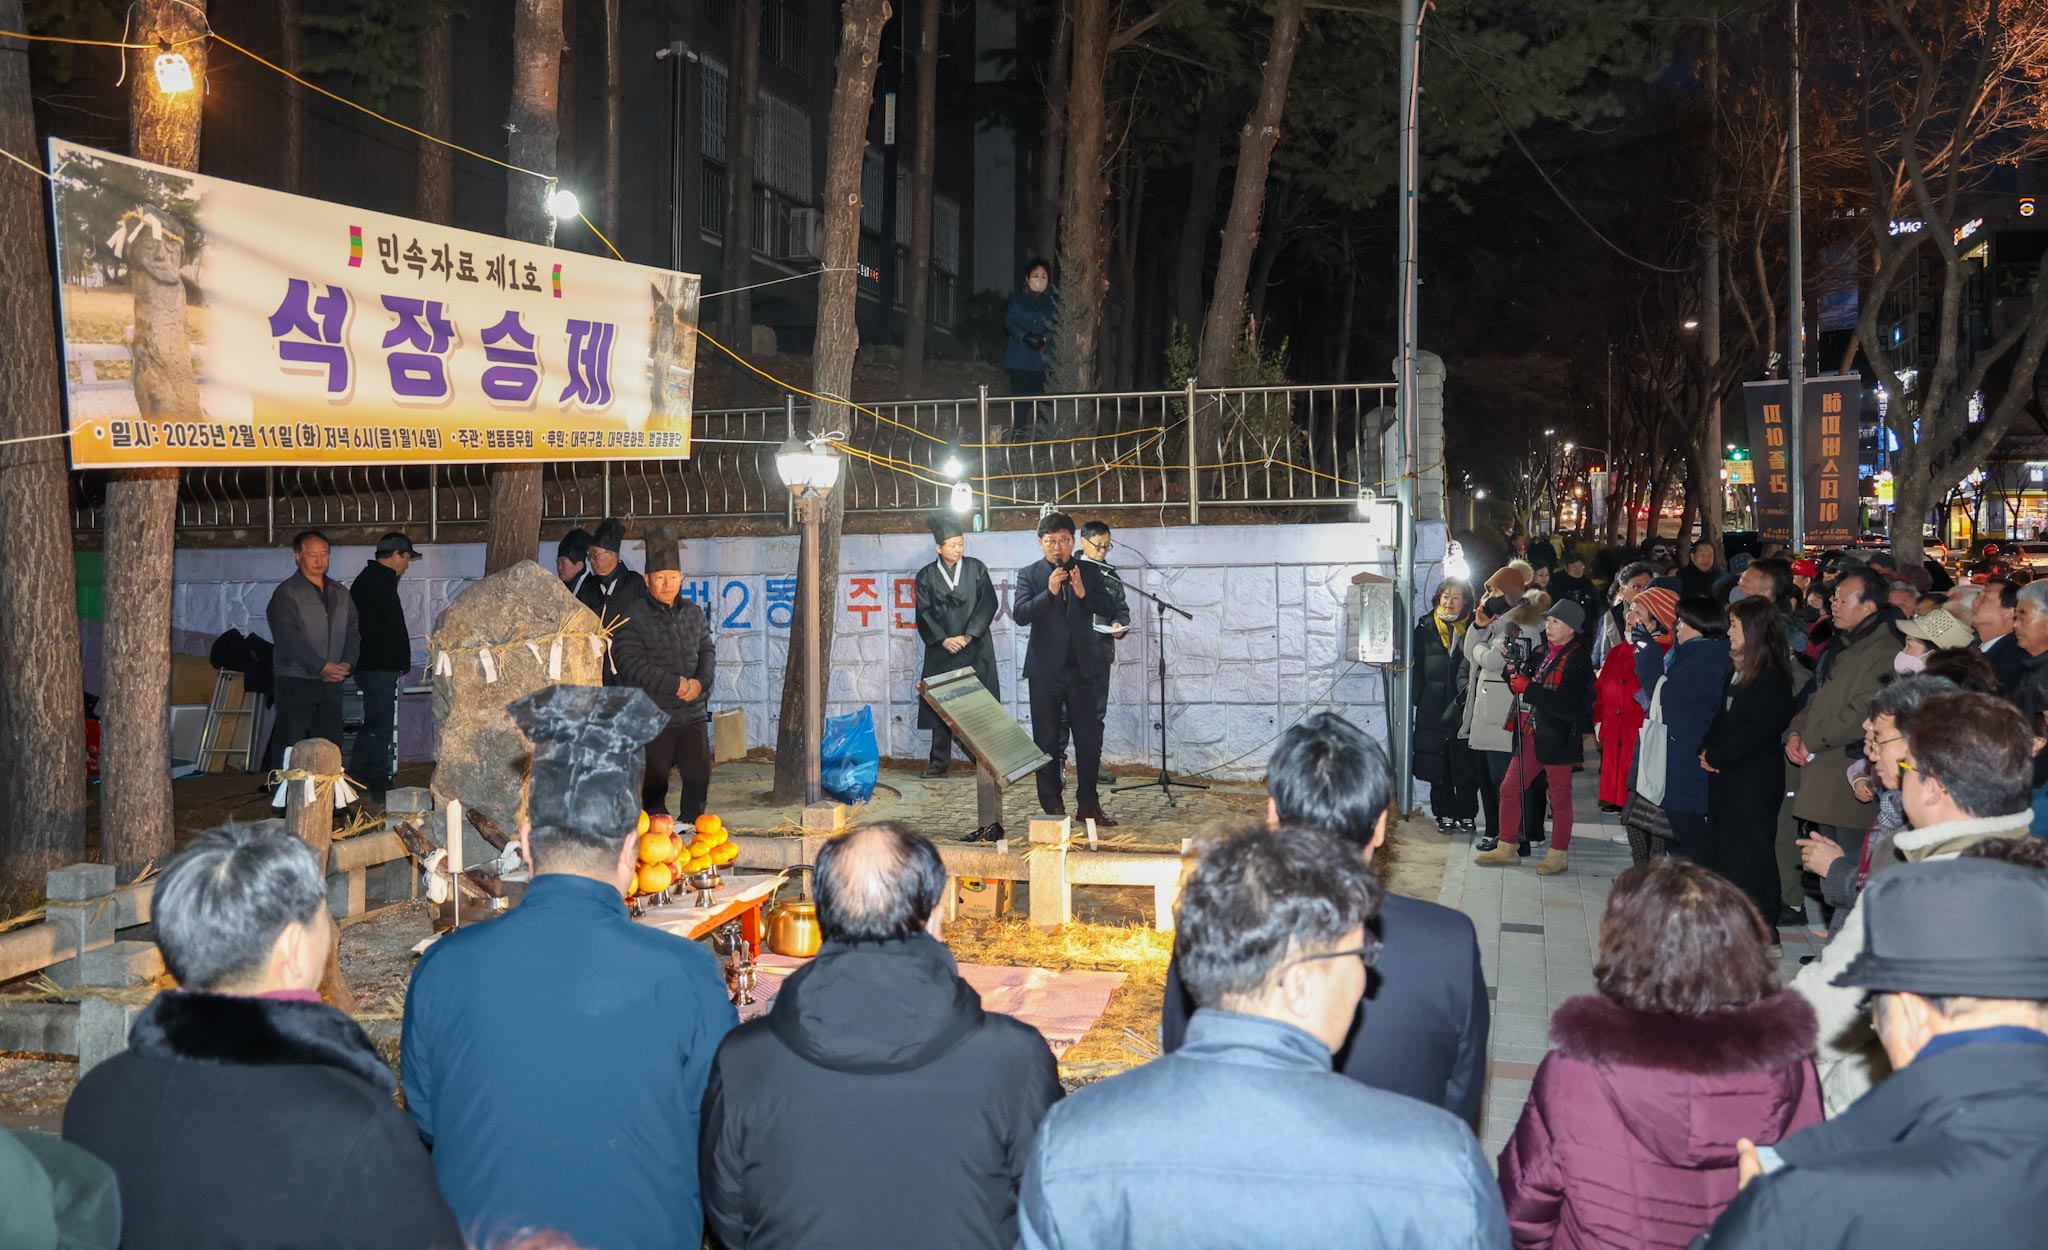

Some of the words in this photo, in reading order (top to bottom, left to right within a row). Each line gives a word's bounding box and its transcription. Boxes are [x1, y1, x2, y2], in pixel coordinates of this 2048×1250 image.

[378, 233, 479, 283] 민속자료
[486, 253, 542, 293] 제1호
[111, 421, 159, 448] 일시:
[163, 423, 226, 448] 2025년
[231, 424, 255, 448] 2월
[458, 429, 483, 448] 주관:
[487, 430, 533, 448] 법동동우회
